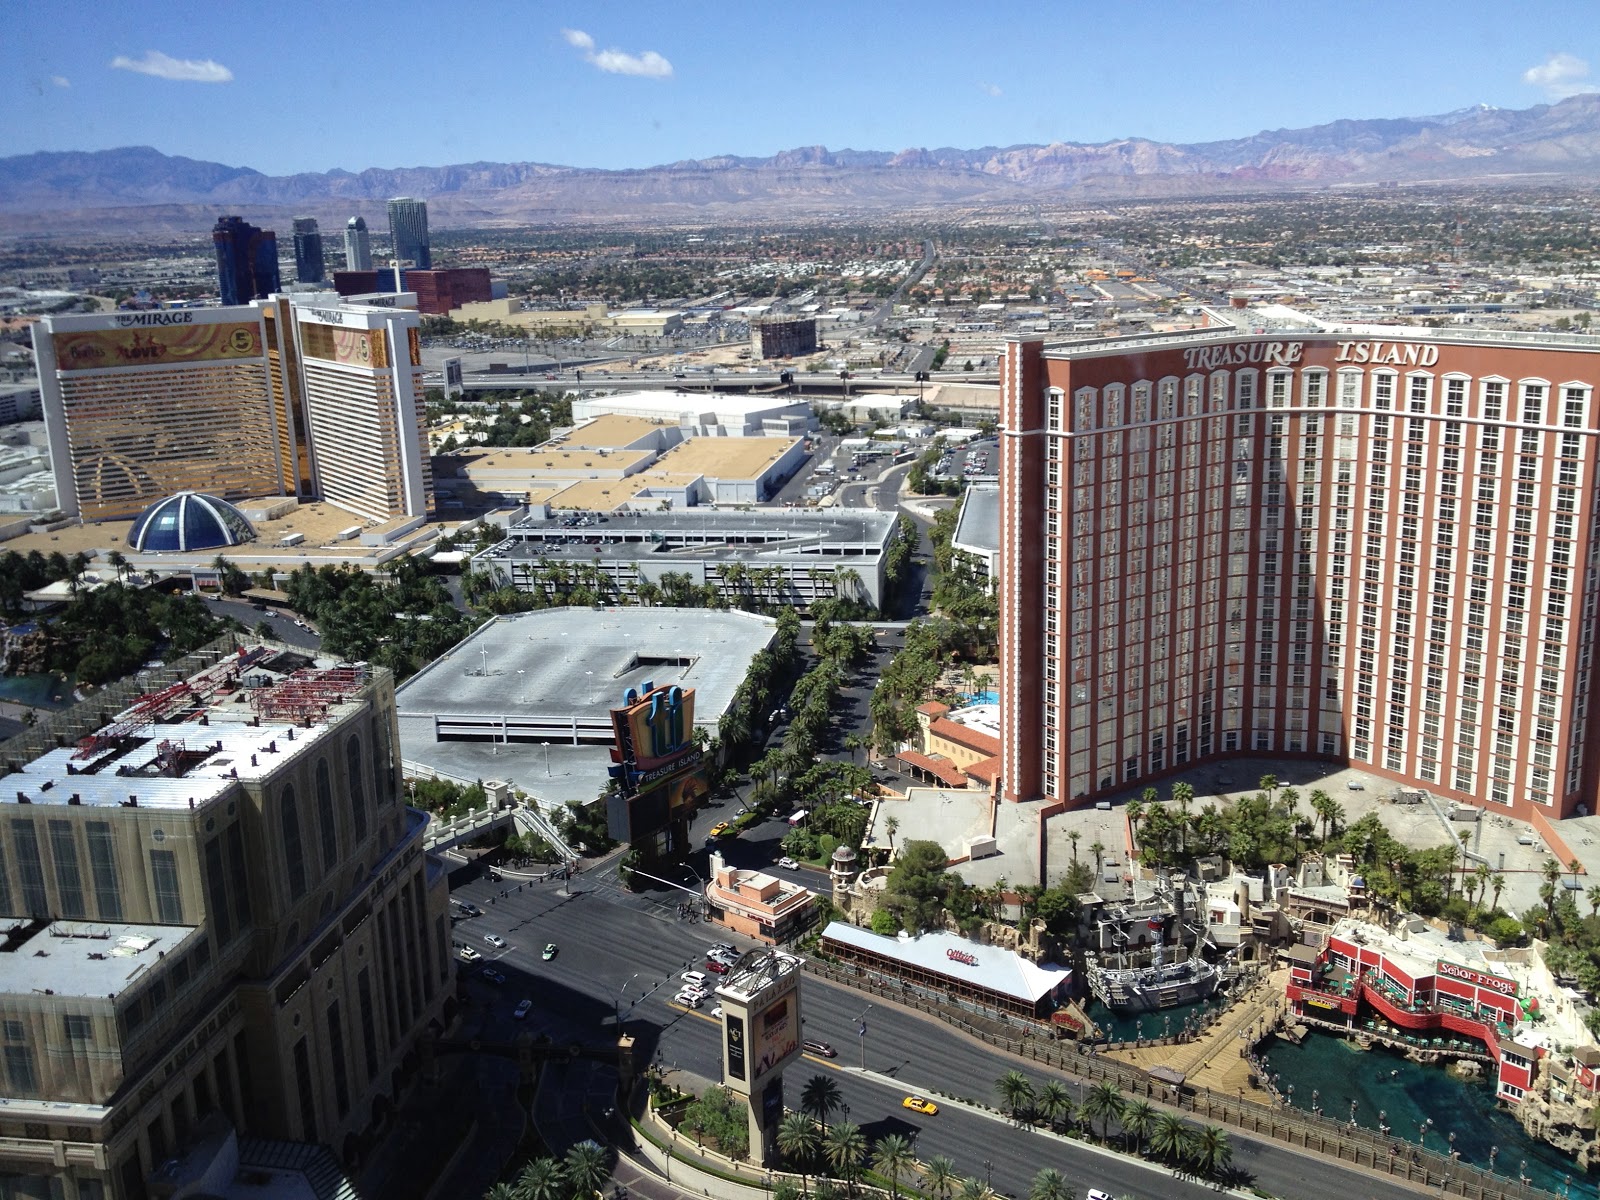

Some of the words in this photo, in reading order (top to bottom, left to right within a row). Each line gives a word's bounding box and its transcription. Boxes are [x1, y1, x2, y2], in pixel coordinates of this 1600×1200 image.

[121, 311, 193, 327] MIRAGE
[124, 346, 160, 359] LOVE
[1183, 341, 1303, 369] TREASURE
[1334, 341, 1439, 367] ISLAND
[645, 764, 676, 782] TREASURE
[678, 751, 701, 768] ISLAND
[753, 975, 796, 1011] PALAZZO
[1477, 974, 1515, 994] Frog's
